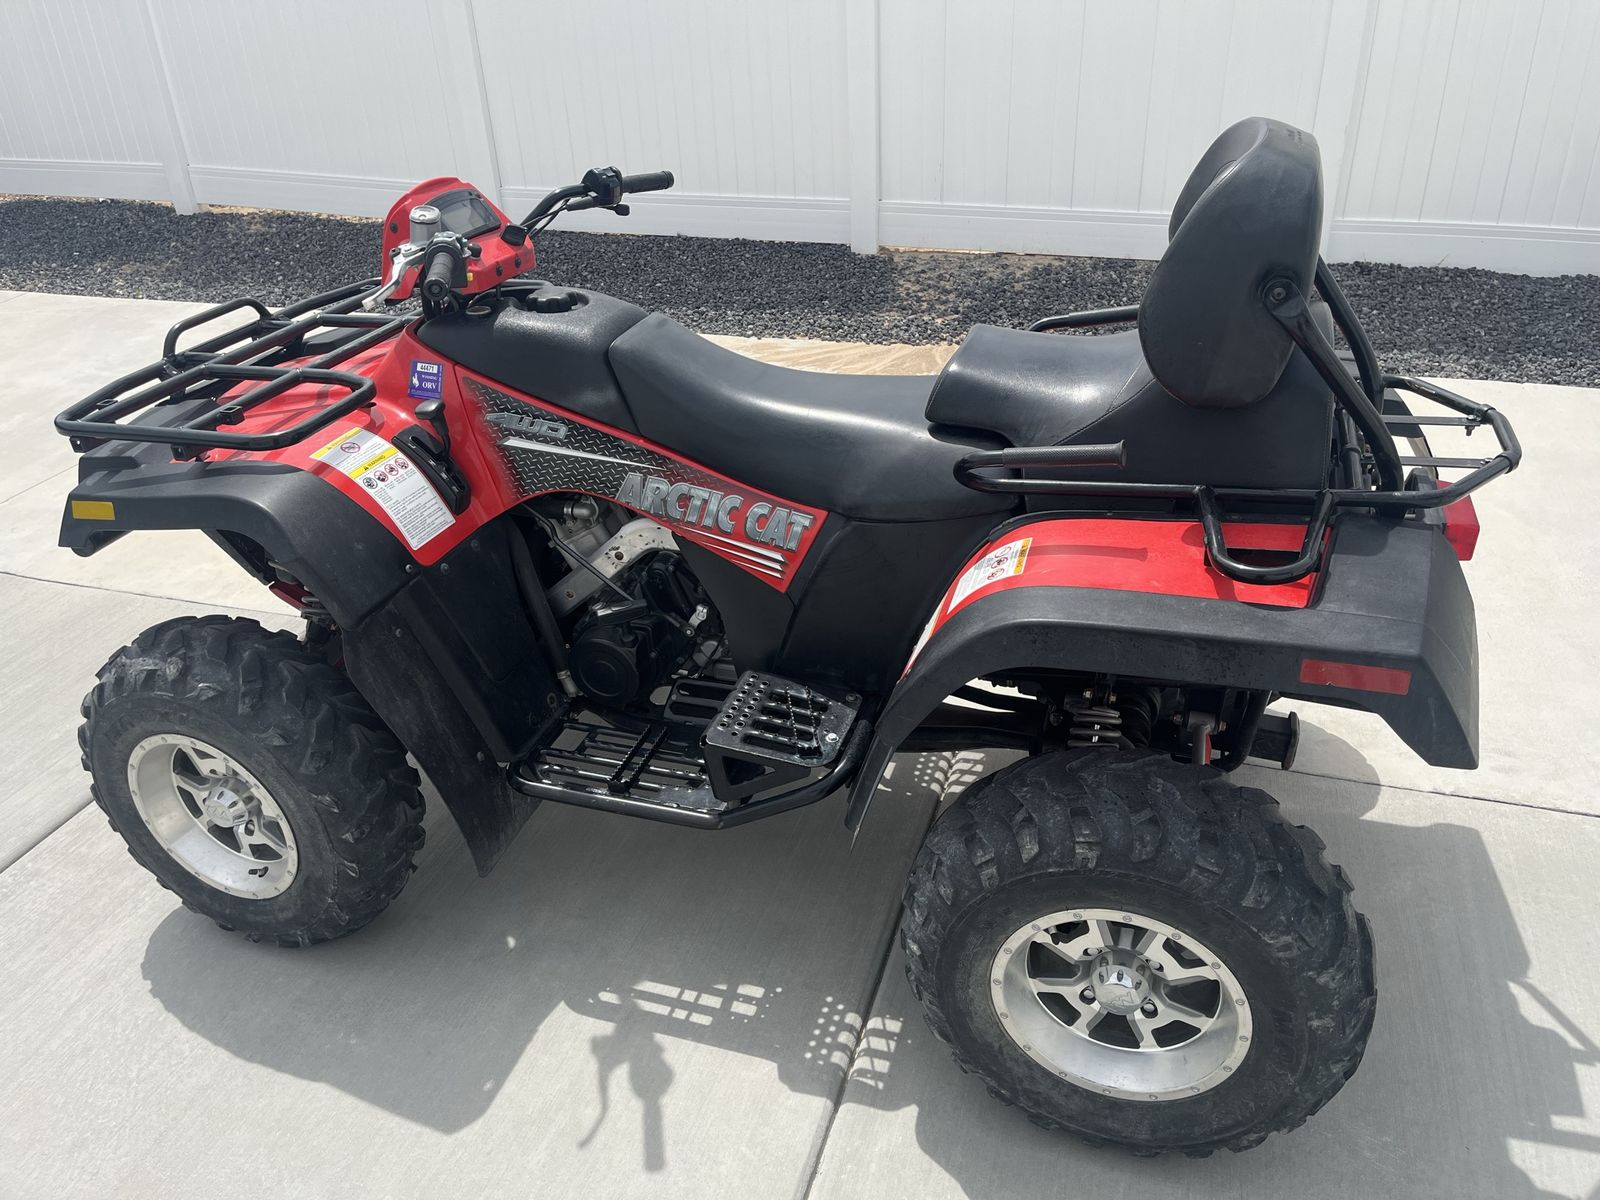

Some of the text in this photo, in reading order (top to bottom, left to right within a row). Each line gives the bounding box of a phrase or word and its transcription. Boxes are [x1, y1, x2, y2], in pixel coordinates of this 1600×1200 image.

[420, 364, 434, 372] 44471
[422, 381, 437, 389] ORV
[615, 472, 815, 553] ARCTIC CAT
